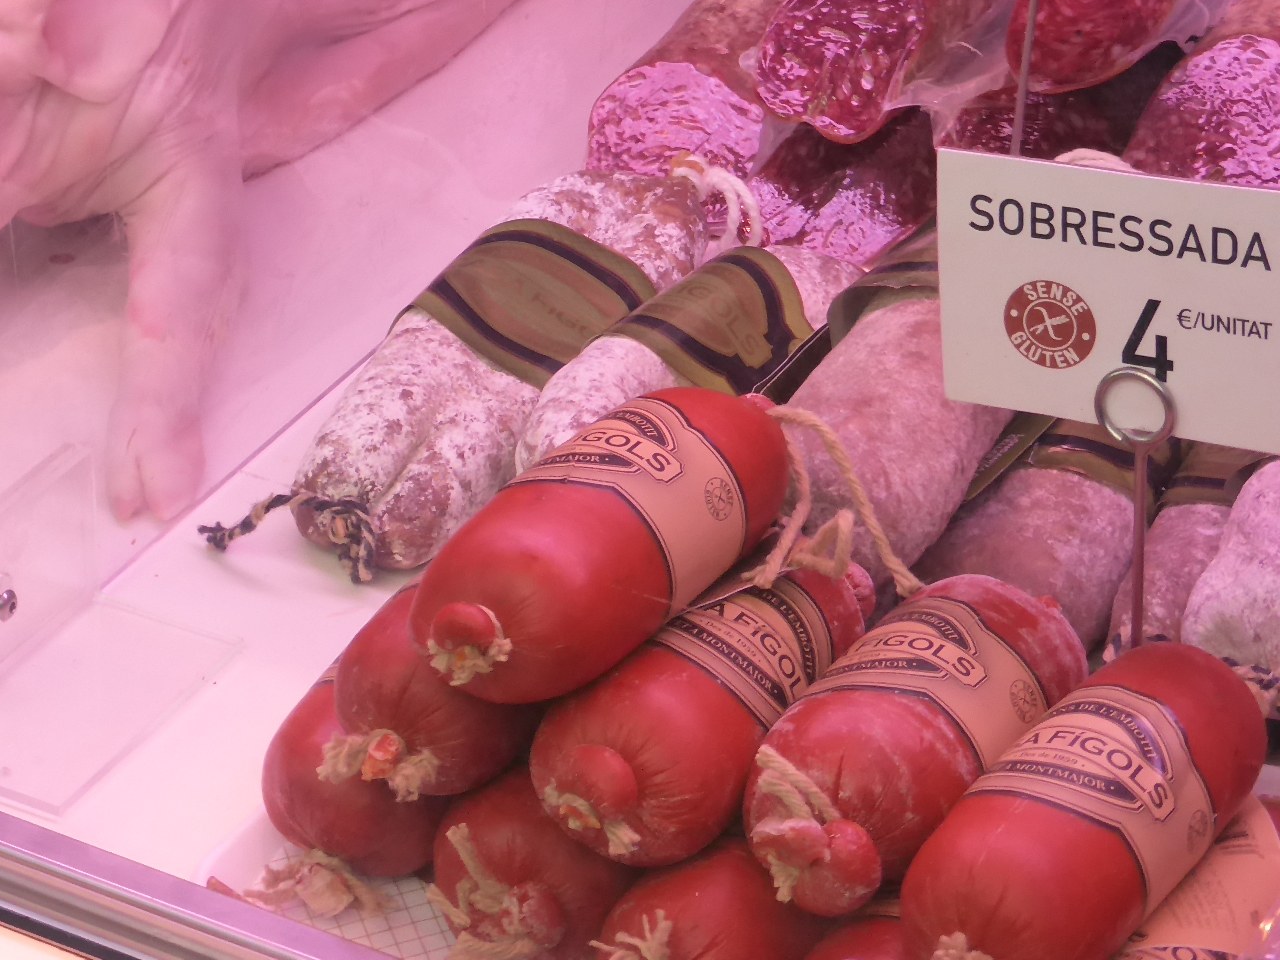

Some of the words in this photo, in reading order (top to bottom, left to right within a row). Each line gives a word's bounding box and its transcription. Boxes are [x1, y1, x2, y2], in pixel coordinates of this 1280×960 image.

[968, 194, 1272, 272] SOBRESSADA
[1023, 281, 1088, 316] SENSE
[1011, 330, 1080, 369] GLUTEN
[1121, 298, 1174, 383] 4
[1176, 308, 1273, 341] €/UNITAT
